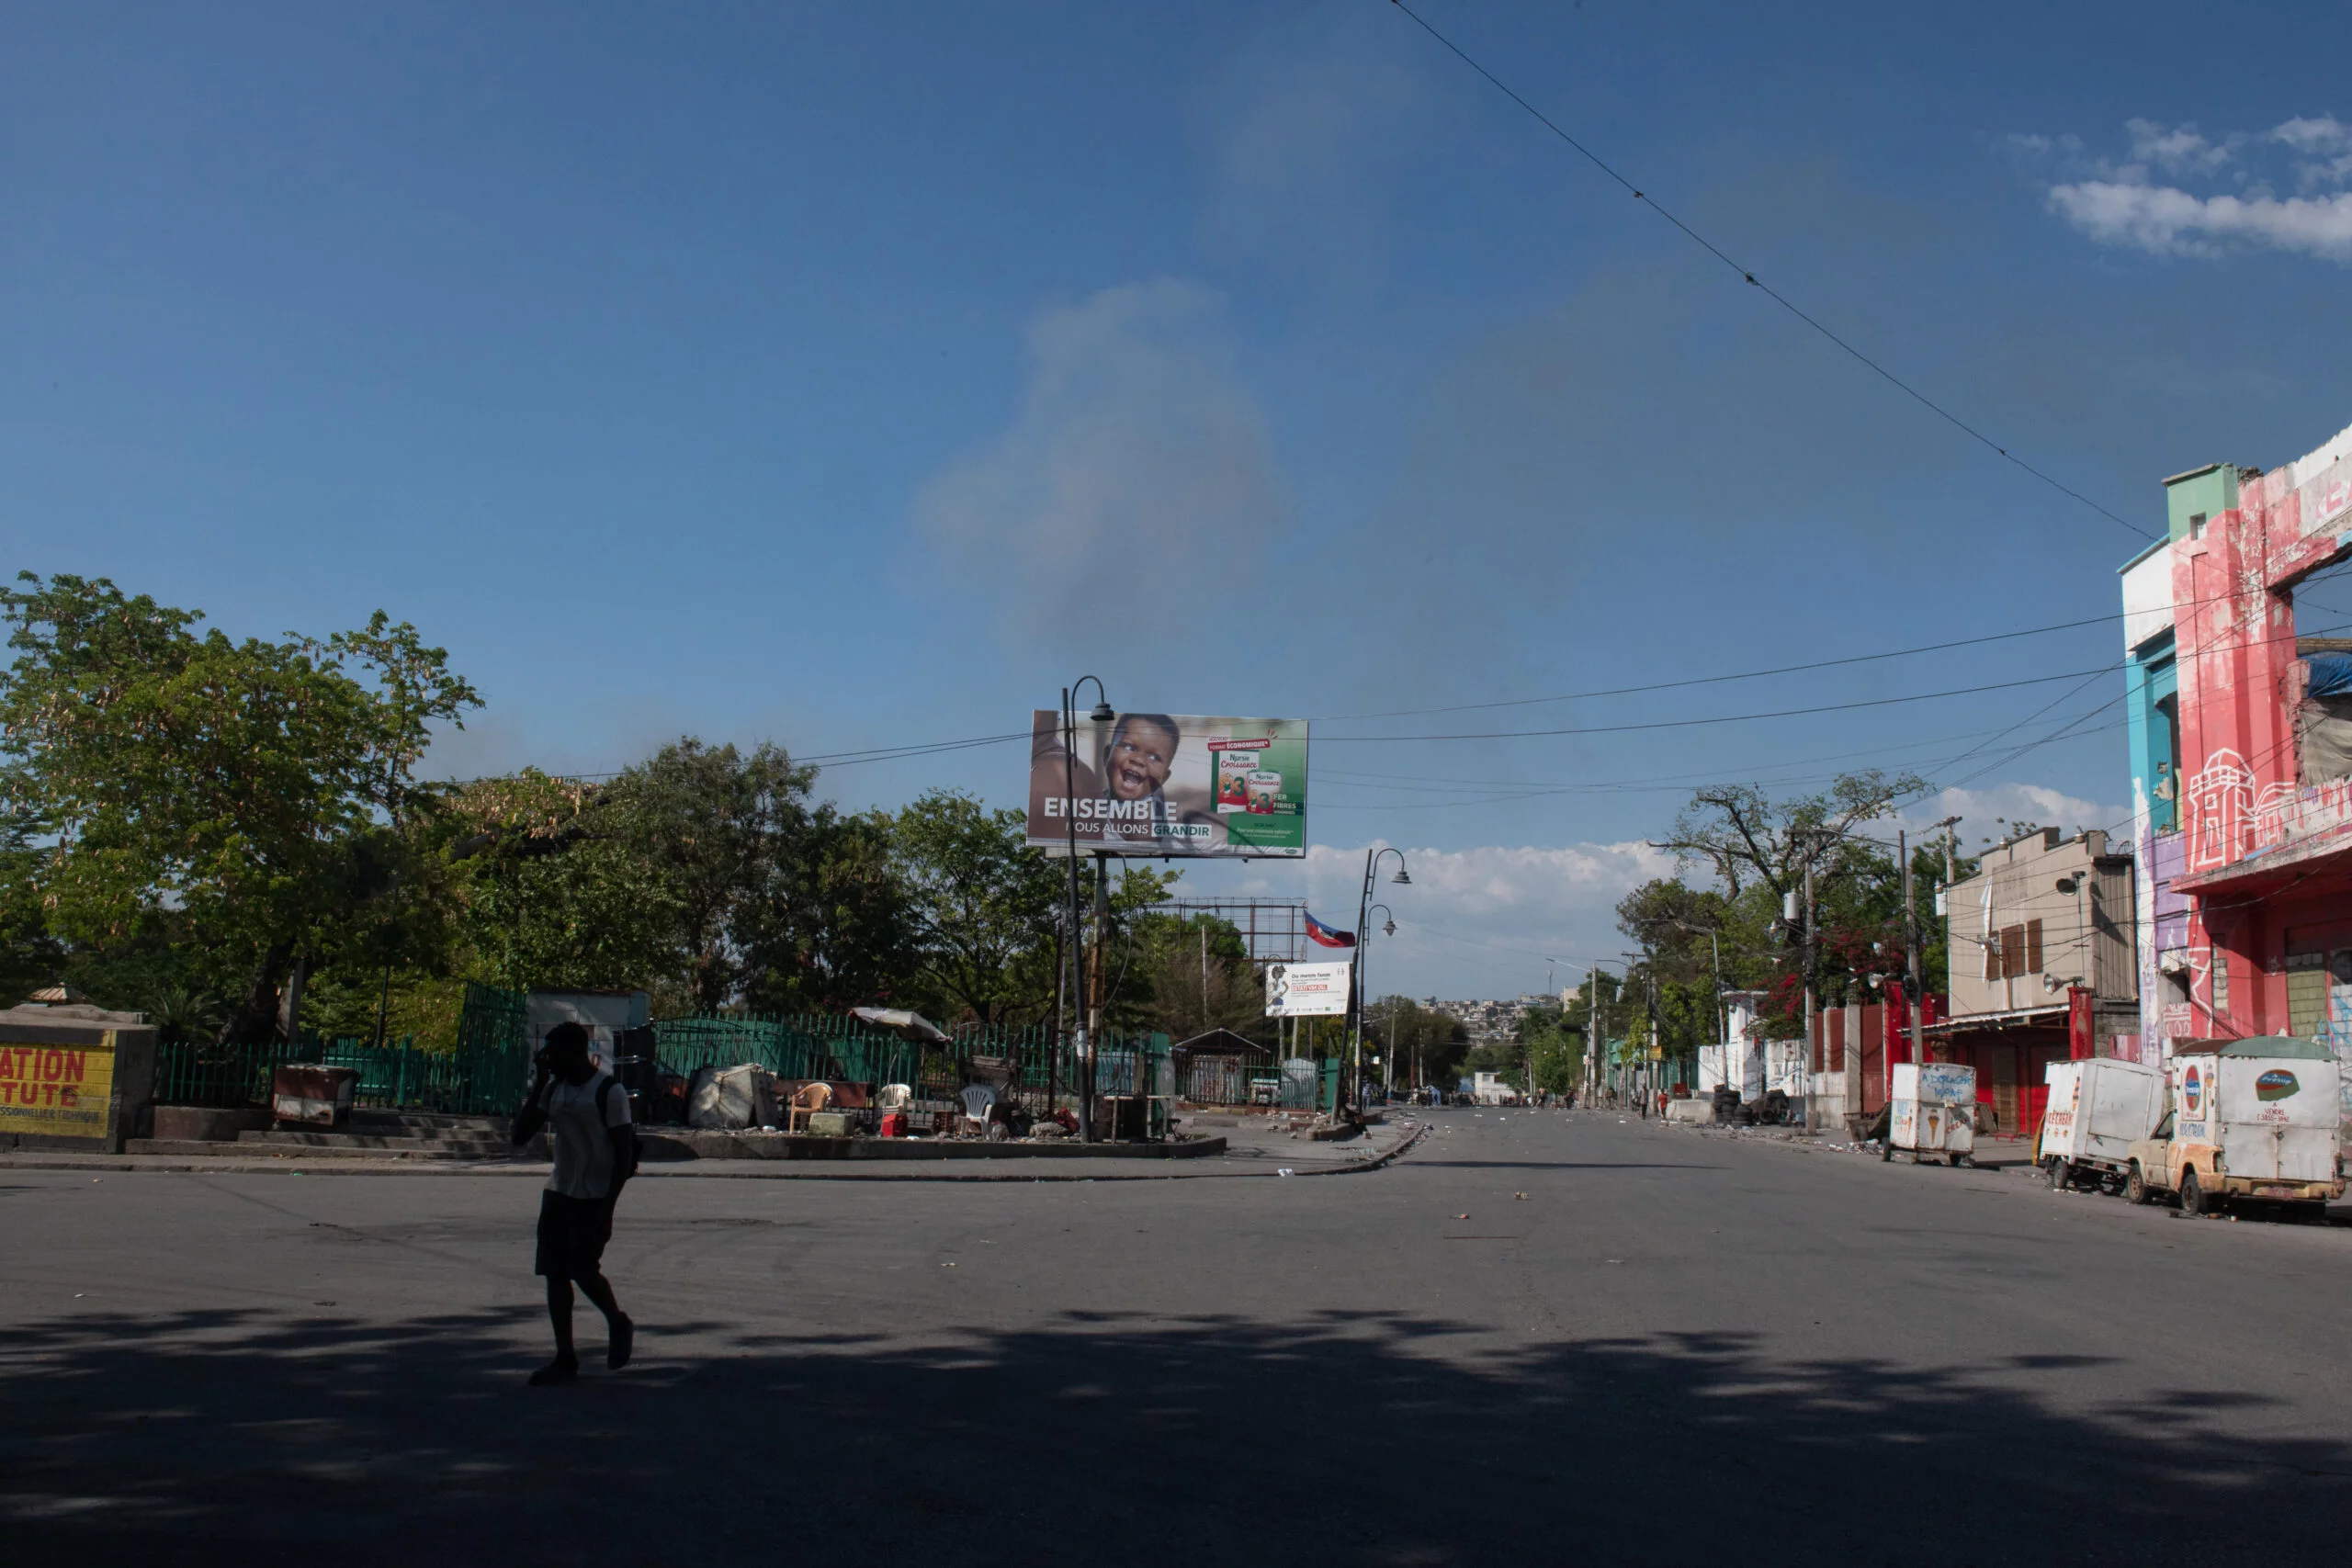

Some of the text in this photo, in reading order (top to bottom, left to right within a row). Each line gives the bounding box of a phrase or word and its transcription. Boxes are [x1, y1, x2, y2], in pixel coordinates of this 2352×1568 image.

[1234, 776, 1244, 795] 3
[1045, 797, 1178, 821] ENSEMBLE
[1261, 793, 1270, 807] 3
[1102, 823, 1148, 834] ALLONS
[1154, 825, 1209, 837] GRANDIR
[1, 1082, 78, 1107] TUTE
